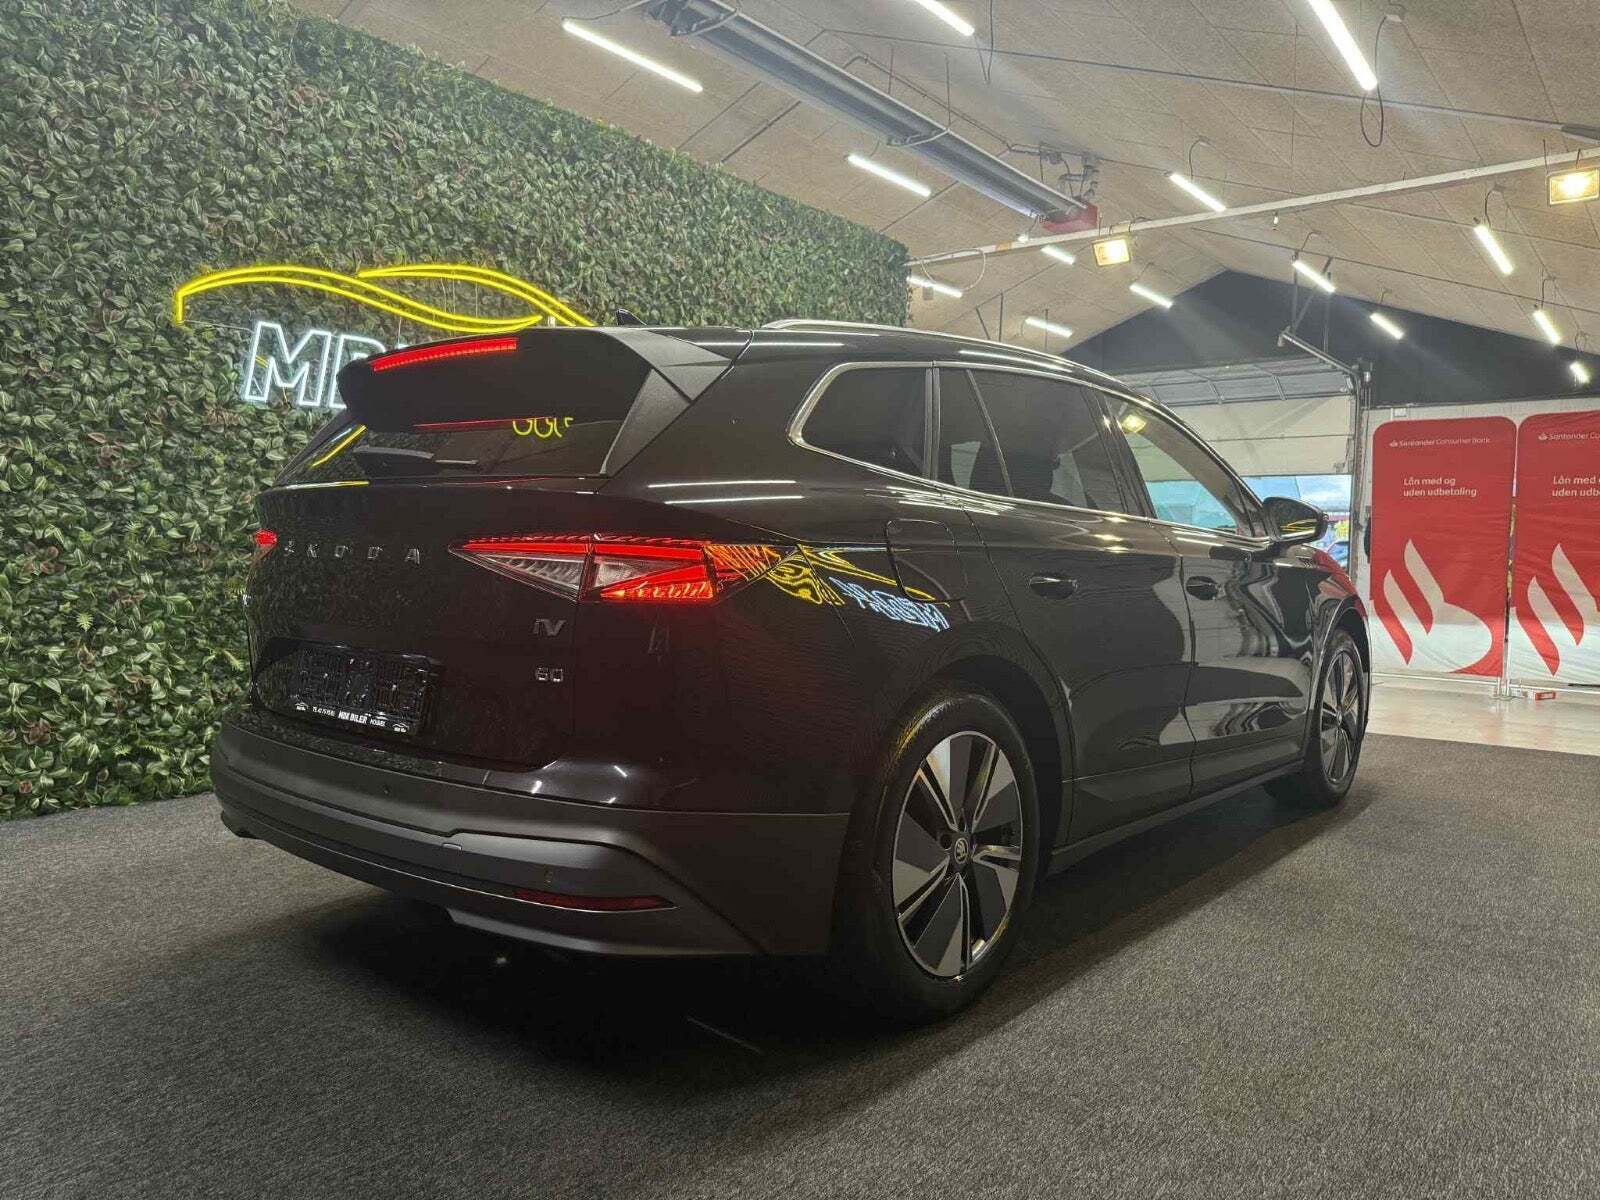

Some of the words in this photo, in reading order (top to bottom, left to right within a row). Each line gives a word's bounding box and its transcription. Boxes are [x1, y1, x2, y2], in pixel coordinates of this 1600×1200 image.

[1403, 477, 1420, 486] Lån
[1421, 477, 1442, 486] med
[1444, 478, 1456, 486] og
[1553, 475, 1571, 485] Lån
[1573, 475, 1596, 485] med
[1403, 488, 1426, 496] uden
[1428, 487, 1477, 497] udbetaling
[1552, 488, 1578, 497] uden
